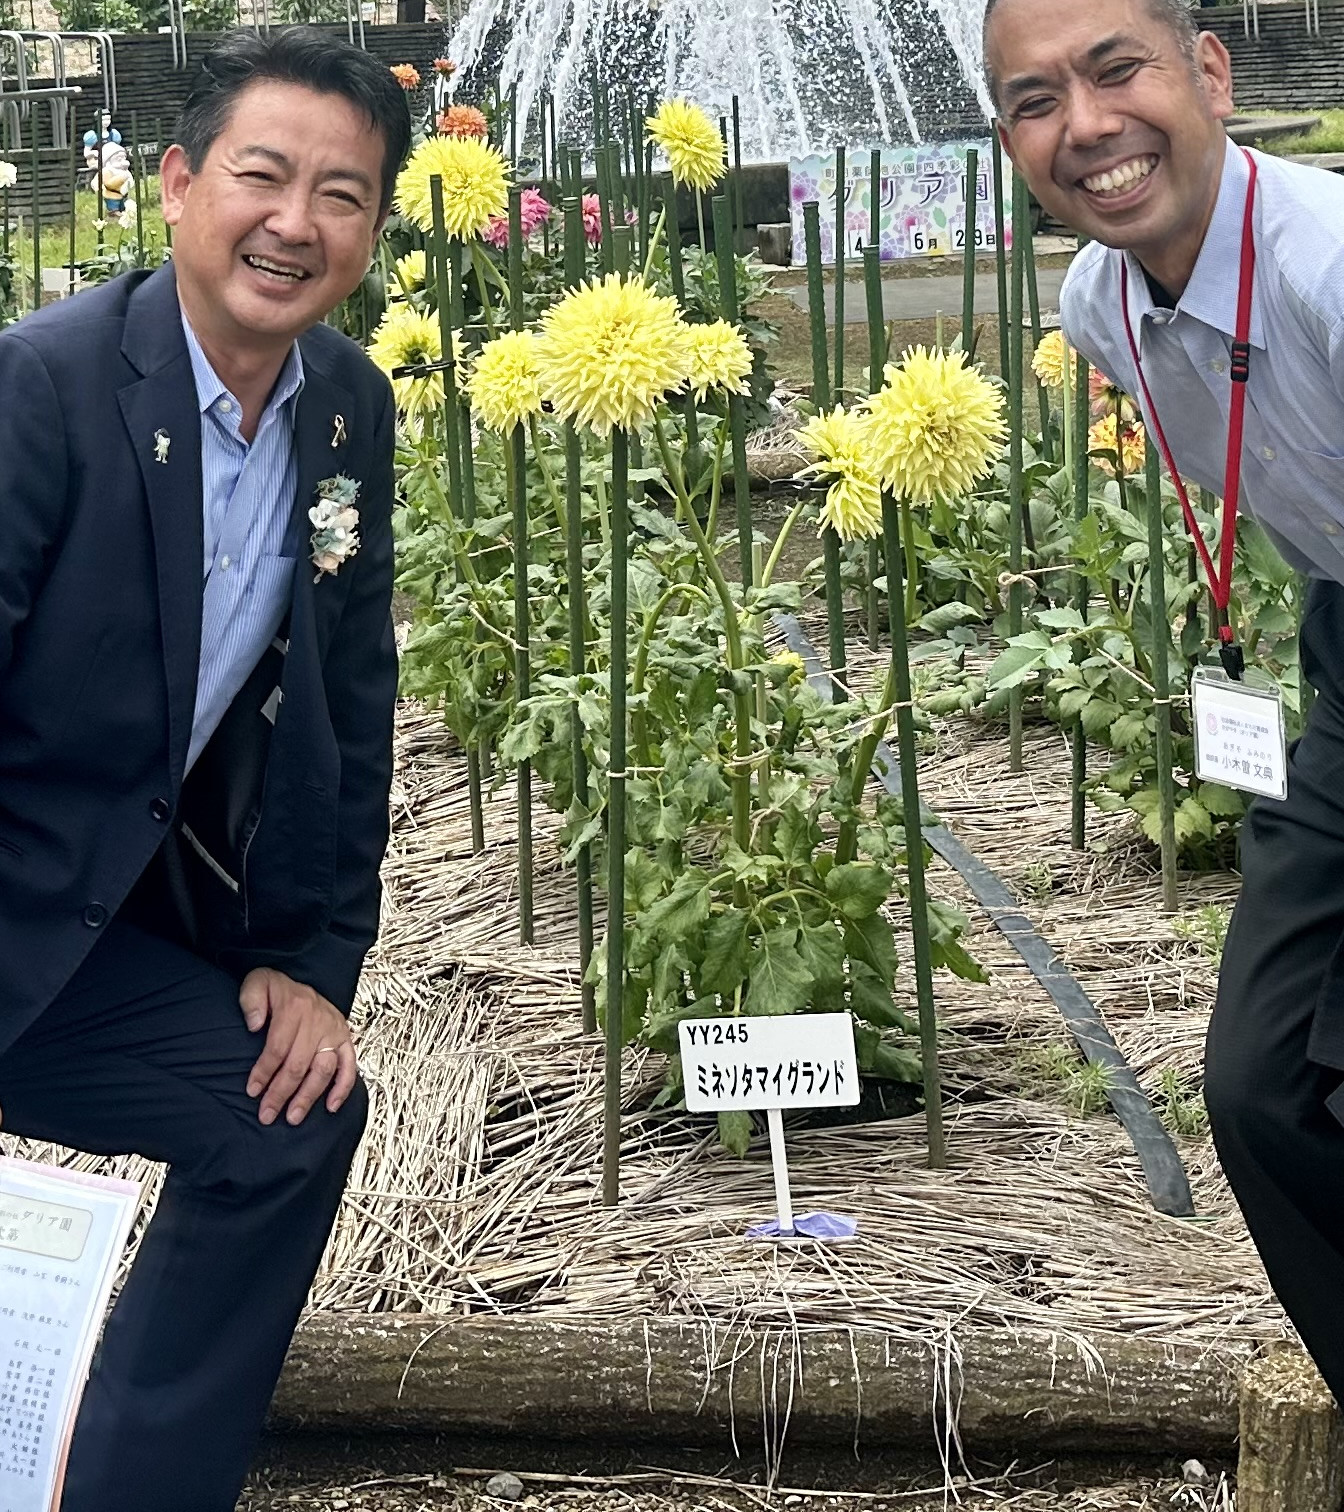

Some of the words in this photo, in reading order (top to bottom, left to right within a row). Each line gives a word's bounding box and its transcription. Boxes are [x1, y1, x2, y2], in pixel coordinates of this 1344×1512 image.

[686, 1023, 749, 1046] YY245
[697, 1058, 845, 1099] ミネソタマイグランド
